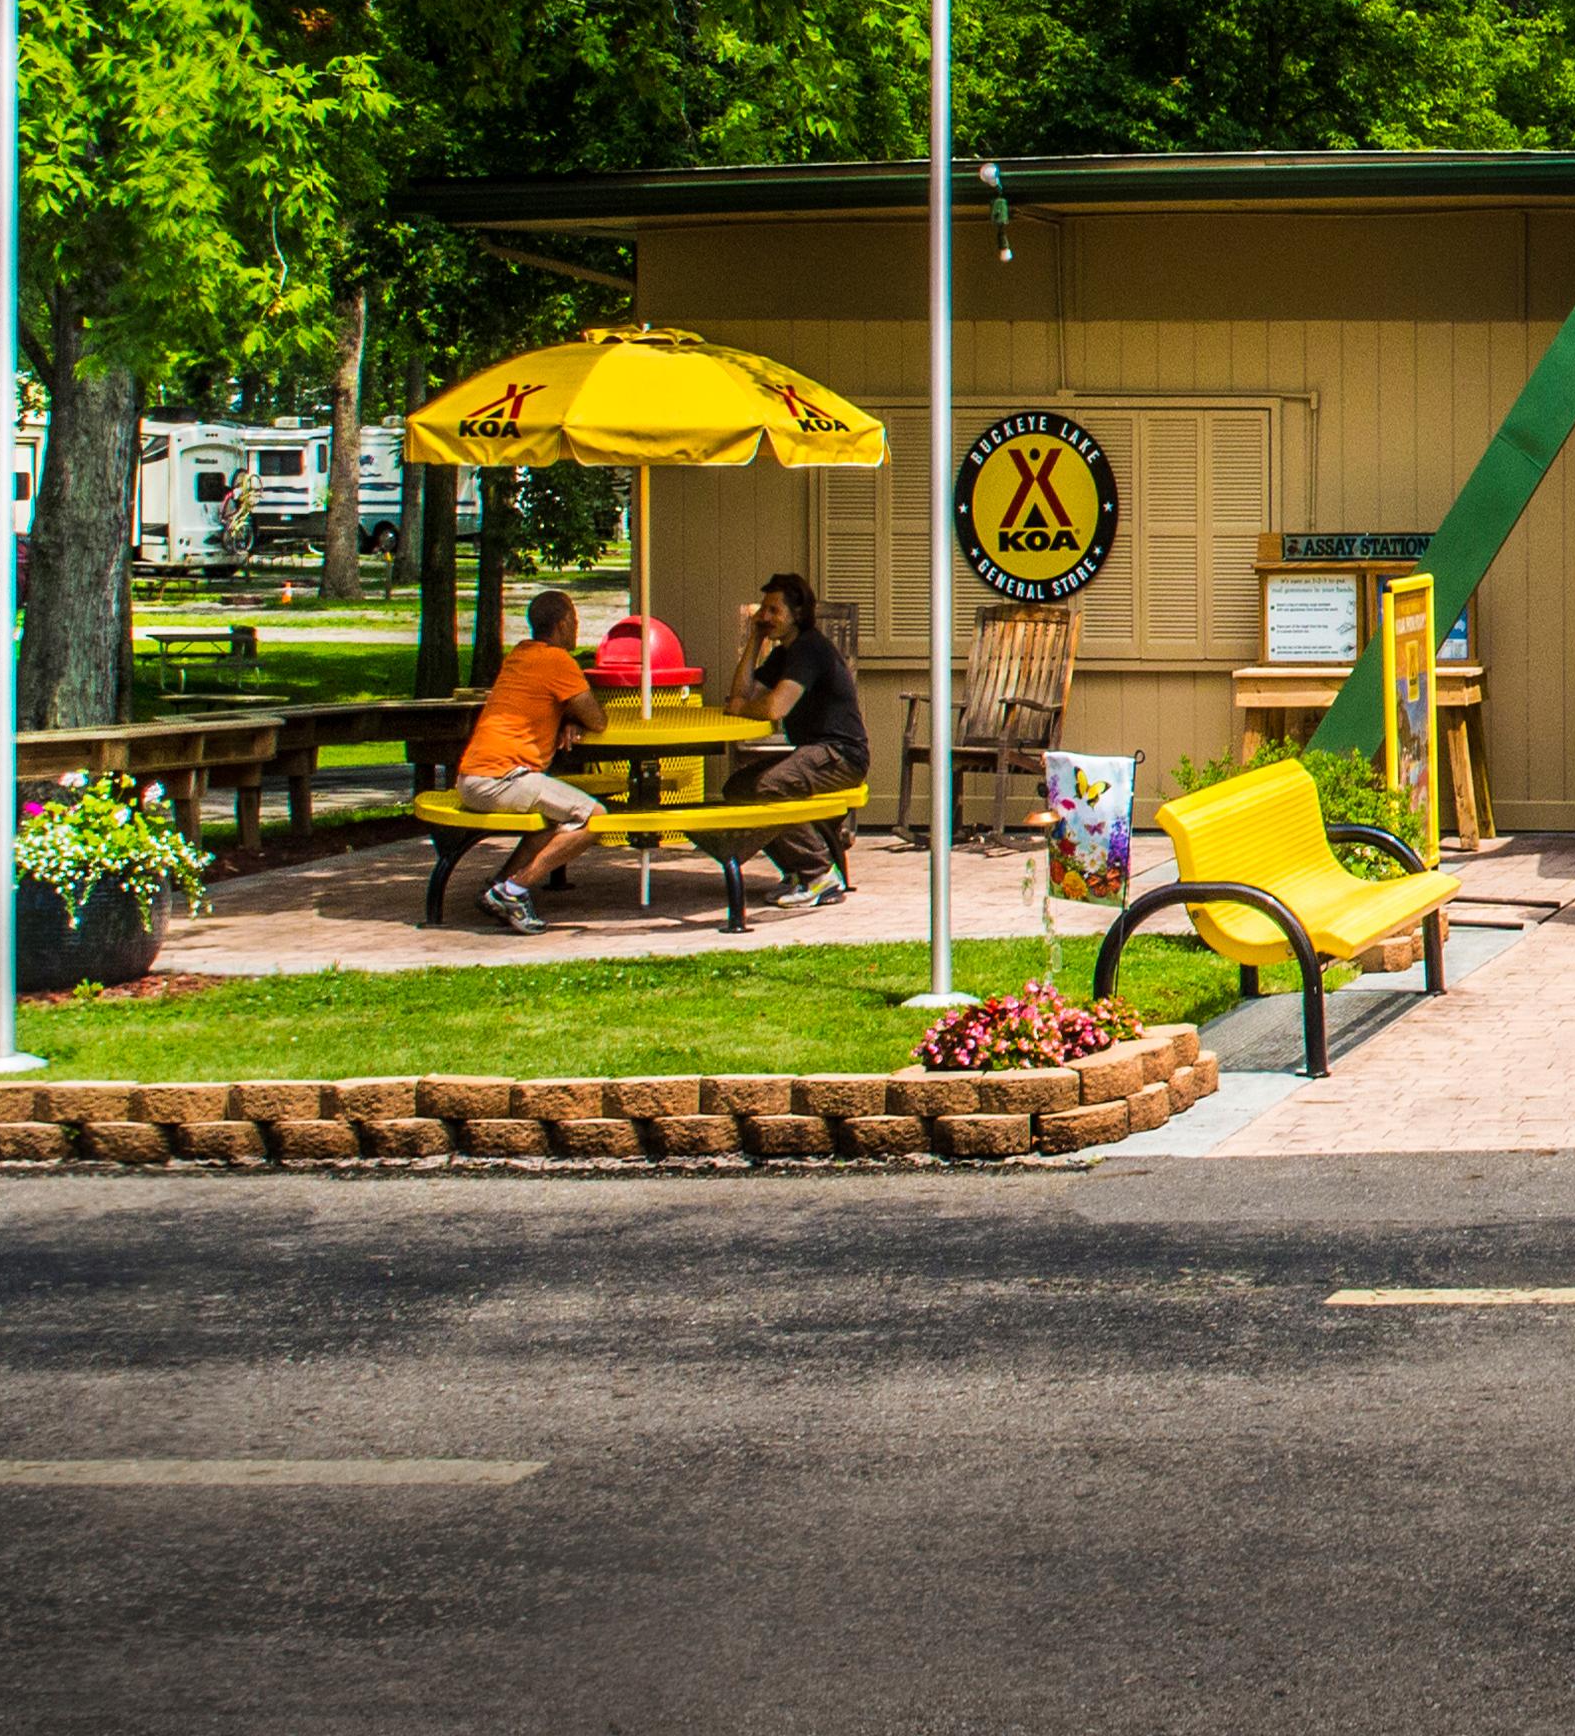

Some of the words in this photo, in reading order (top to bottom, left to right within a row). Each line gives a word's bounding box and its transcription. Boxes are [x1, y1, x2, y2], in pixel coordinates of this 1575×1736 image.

[458, 420, 522, 438] KOA
[797, 419, 851, 432] KOA
[970, 415, 1048, 465] BUCKEYE
[1060, 422, 1101, 464] LAKE
[999, 530, 1081, 552] KOA
[1303, 537, 1357, 556] ASSAY
[1359, 537, 1431, 556] STATION
[977, 559, 1045, 600] GENERAL
[1052, 558, 1097, 597] STORE
